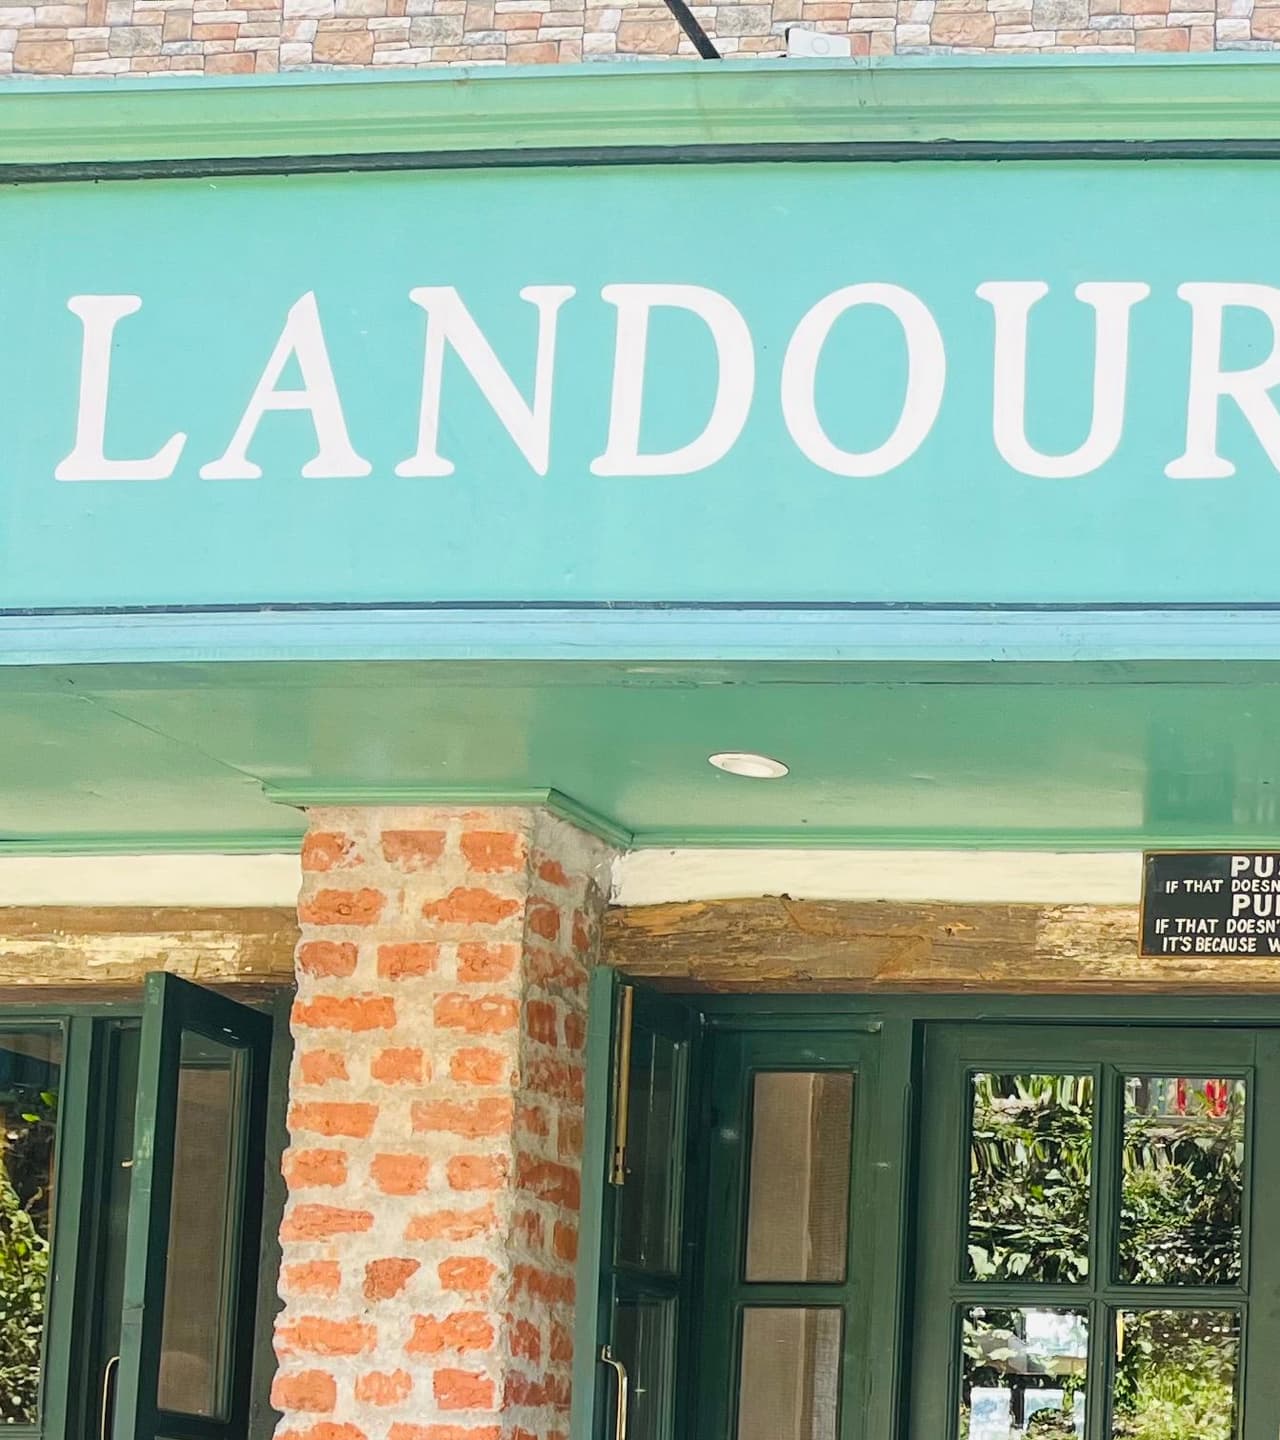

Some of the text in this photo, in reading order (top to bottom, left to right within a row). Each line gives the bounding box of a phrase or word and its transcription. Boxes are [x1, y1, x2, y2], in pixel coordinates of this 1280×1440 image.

[1166, 880, 1179, 894] IF
[1183, 879, 1224, 893] THAT
[1156, 918, 1169, 934] IF
[1175, 918, 1219, 934] THAT
[1163, 936, 1192, 952] IT'S
[1195, 936, 1257, 953] BECAUSE
